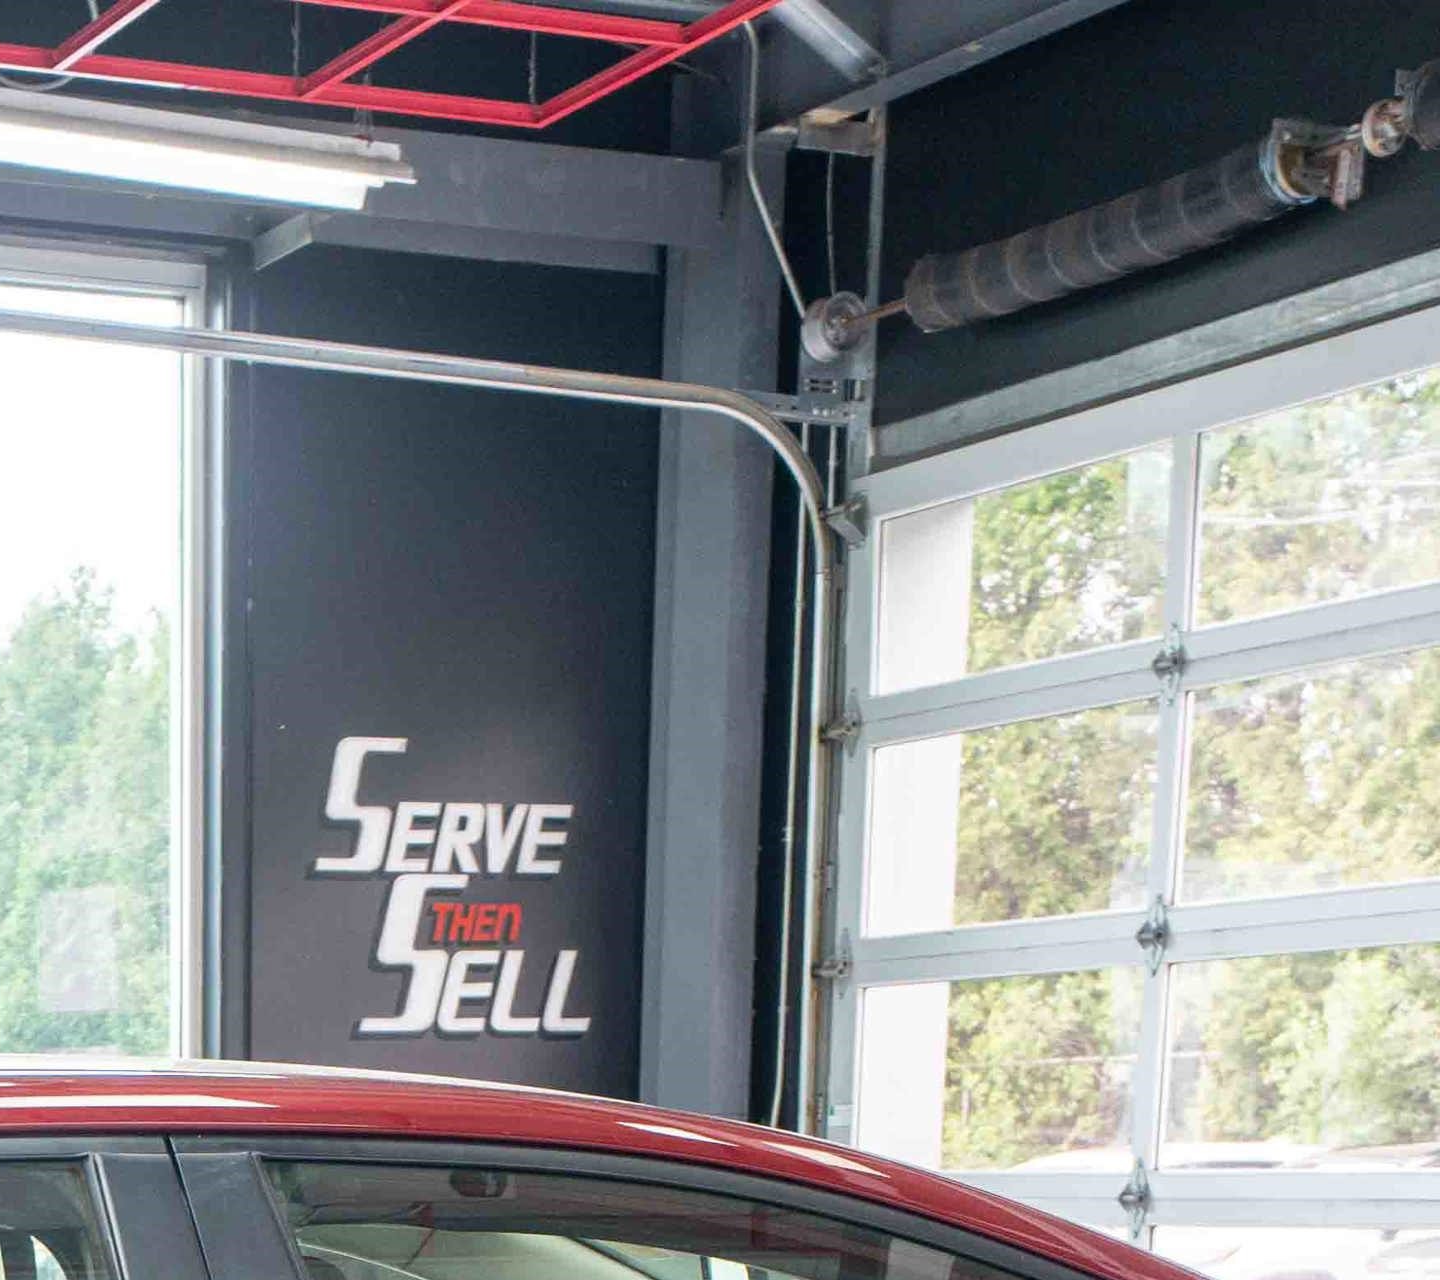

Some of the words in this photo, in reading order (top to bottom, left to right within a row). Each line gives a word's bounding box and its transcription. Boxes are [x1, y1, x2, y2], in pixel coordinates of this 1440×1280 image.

[315, 736, 575, 874] SERVE
[358, 873, 592, 1033] SELL
[432, 902, 523, 942] THEN
